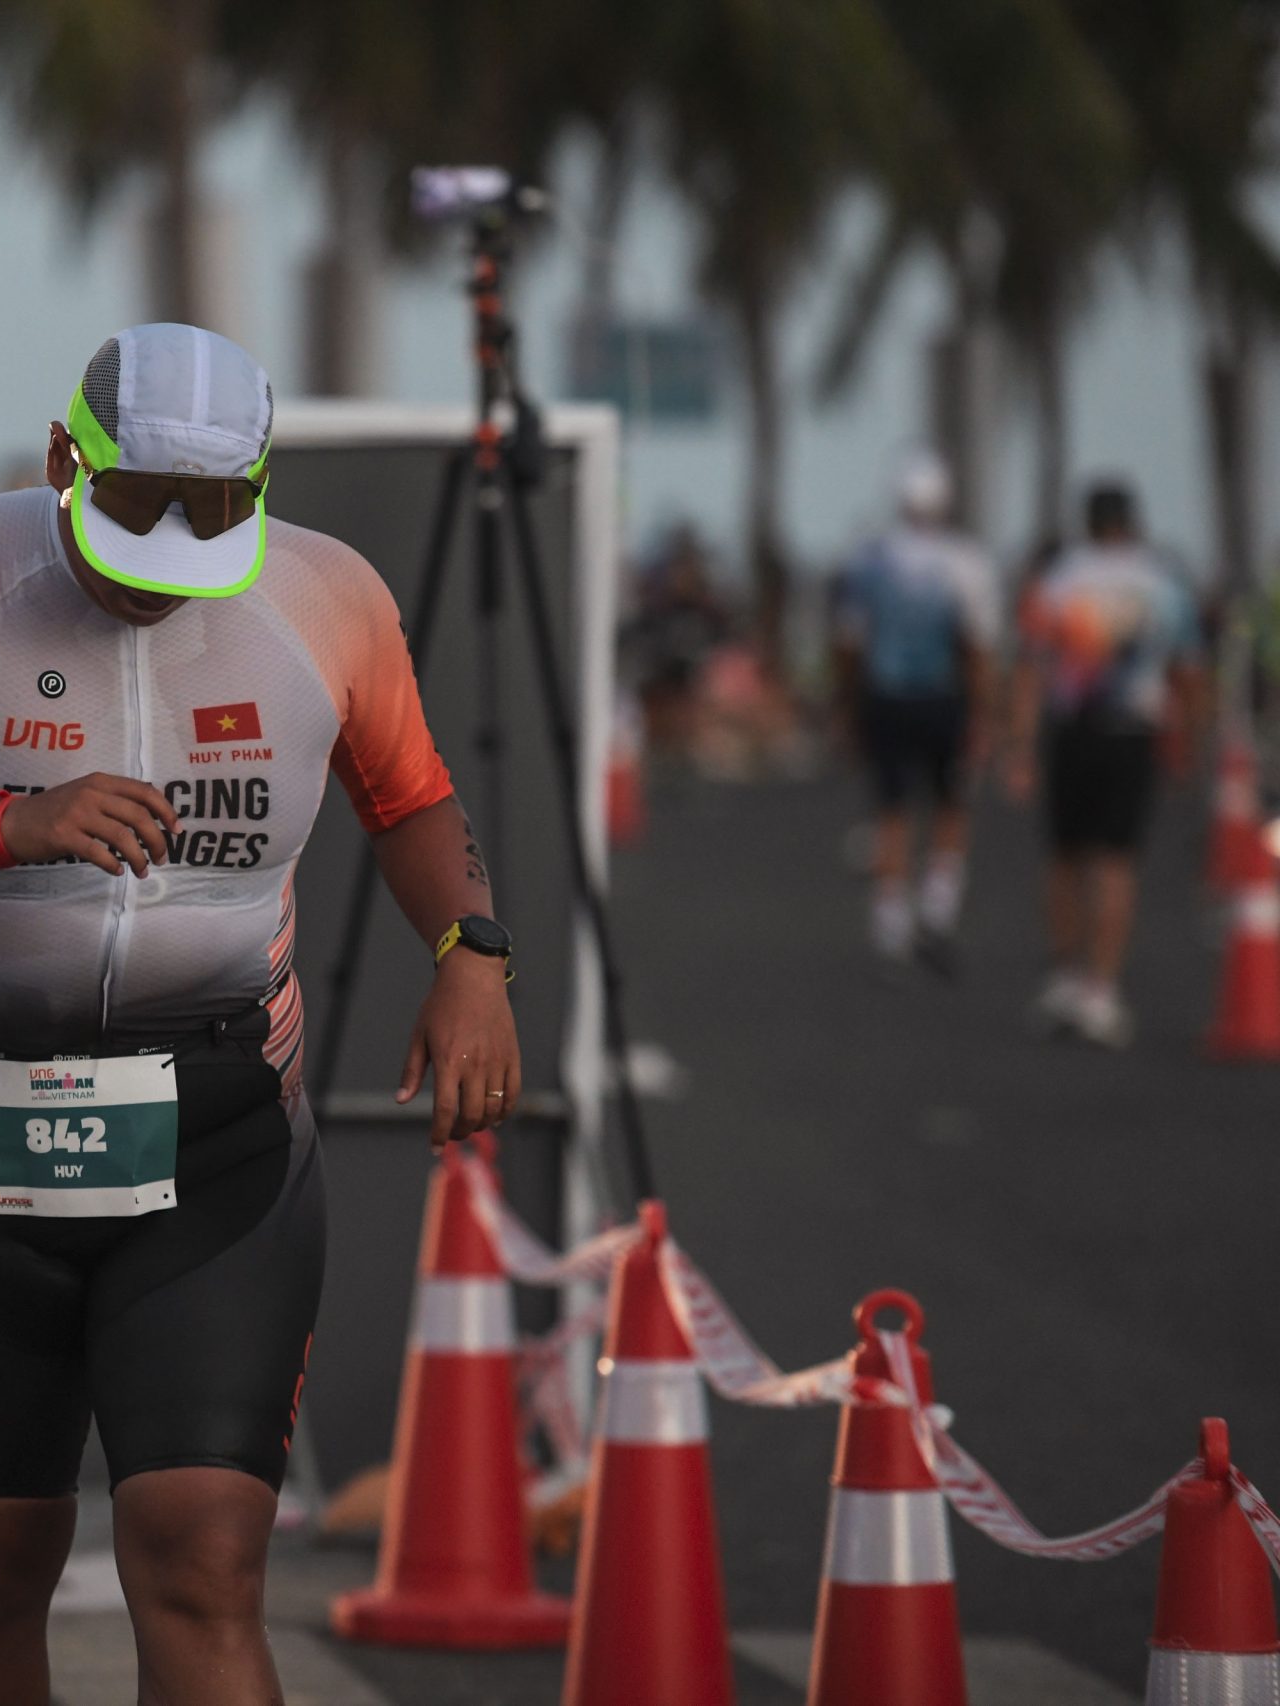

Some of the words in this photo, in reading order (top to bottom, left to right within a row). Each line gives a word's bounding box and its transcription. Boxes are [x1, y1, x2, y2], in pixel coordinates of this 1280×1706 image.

[3, 717, 85, 750] VNG
[189, 751, 222, 764] HUY
[231, 748, 273, 762] PHAM
[29, 1068, 55, 1080] VNG
[30, 1076, 95, 1090] IRONMAN
[52, 1091, 95, 1100] VIETNAM
[25, 1117, 107, 1154] 842
[54, 1165, 84, 1178] HUY
